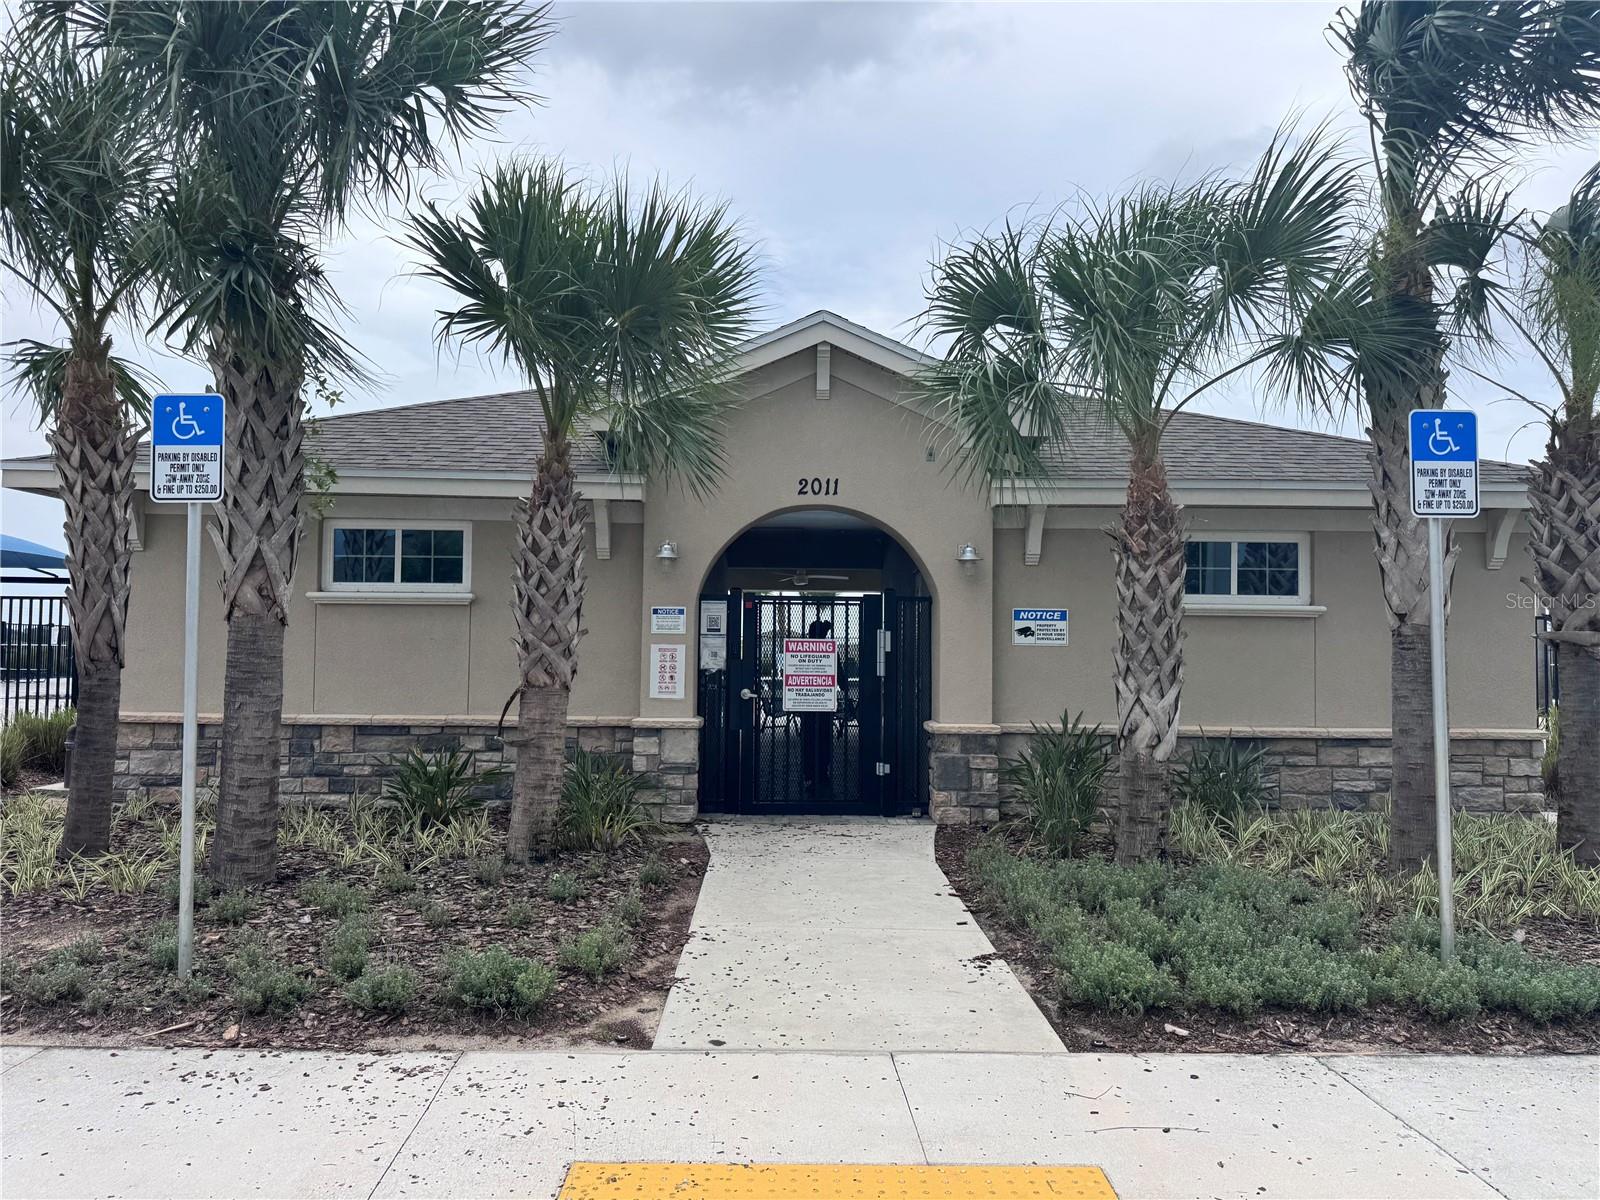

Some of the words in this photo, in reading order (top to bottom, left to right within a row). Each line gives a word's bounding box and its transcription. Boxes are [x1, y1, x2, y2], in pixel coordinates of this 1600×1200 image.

[157, 452, 181, 462] PARKING
[182, 452, 190, 462] BY
[190, 452, 218, 462] DISABLED
[169, 463, 190, 473] PERMIT
[191, 463, 206, 473] ONLY
[1416, 468, 1439, 478] PARKING
[1439, 468, 1447, 478] BY
[1447, 468, 1473, 478] DISABLED
[164, 473, 195, 484] TOW-AWAY
[195, 473, 210, 484] ZONE
[1428, 478, 1448, 489] PERMIT
[1448, 478, 1462, 489] ONLY
[156, 484, 162, 494] &
[162, 484, 175, 494] FINE
[176, 484, 185, 494] UP
[185, 484, 193, 494] TO
[194, 484, 218, 494] $250.00
[797, 477, 839, 496] 2011
[1424, 489, 1452, 499] TOW-AWAY
[1453, 489, 1467, 499] ZONE
[1417, 499, 1422, 509] &
[1422, 499, 1435, 510] FINE
[1435, 499, 1443, 510] UP
[1444, 499, 1451, 510] TO
[1452, 499, 1474, 510] $250.00
[1019, 611, 1062, 620] NOTICE
[788, 642, 834, 652] WARNING
[787, 676, 833, 686] ADVERTENCIA
